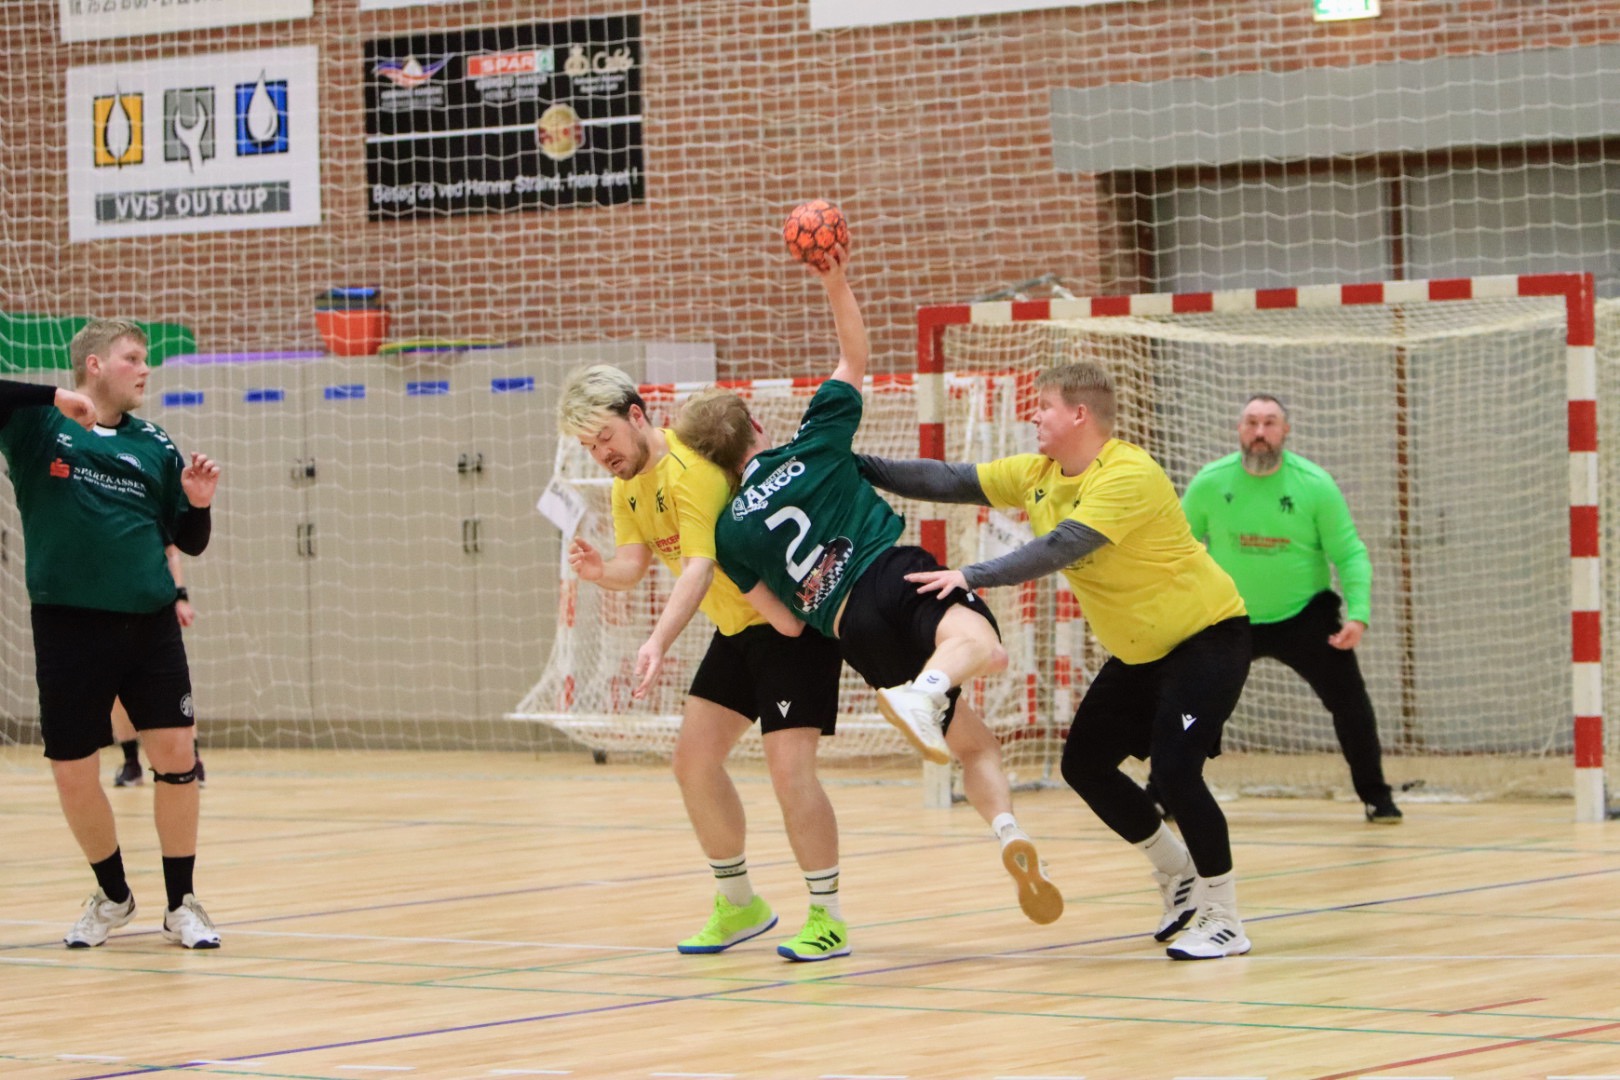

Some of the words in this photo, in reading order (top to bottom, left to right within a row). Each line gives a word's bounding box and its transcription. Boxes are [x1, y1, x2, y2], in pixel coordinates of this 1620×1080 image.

[482, 56, 538, 73] SPAR
[74, 466, 147, 492] SPAREKASSEN
[764, 505, 825, 583] 2
